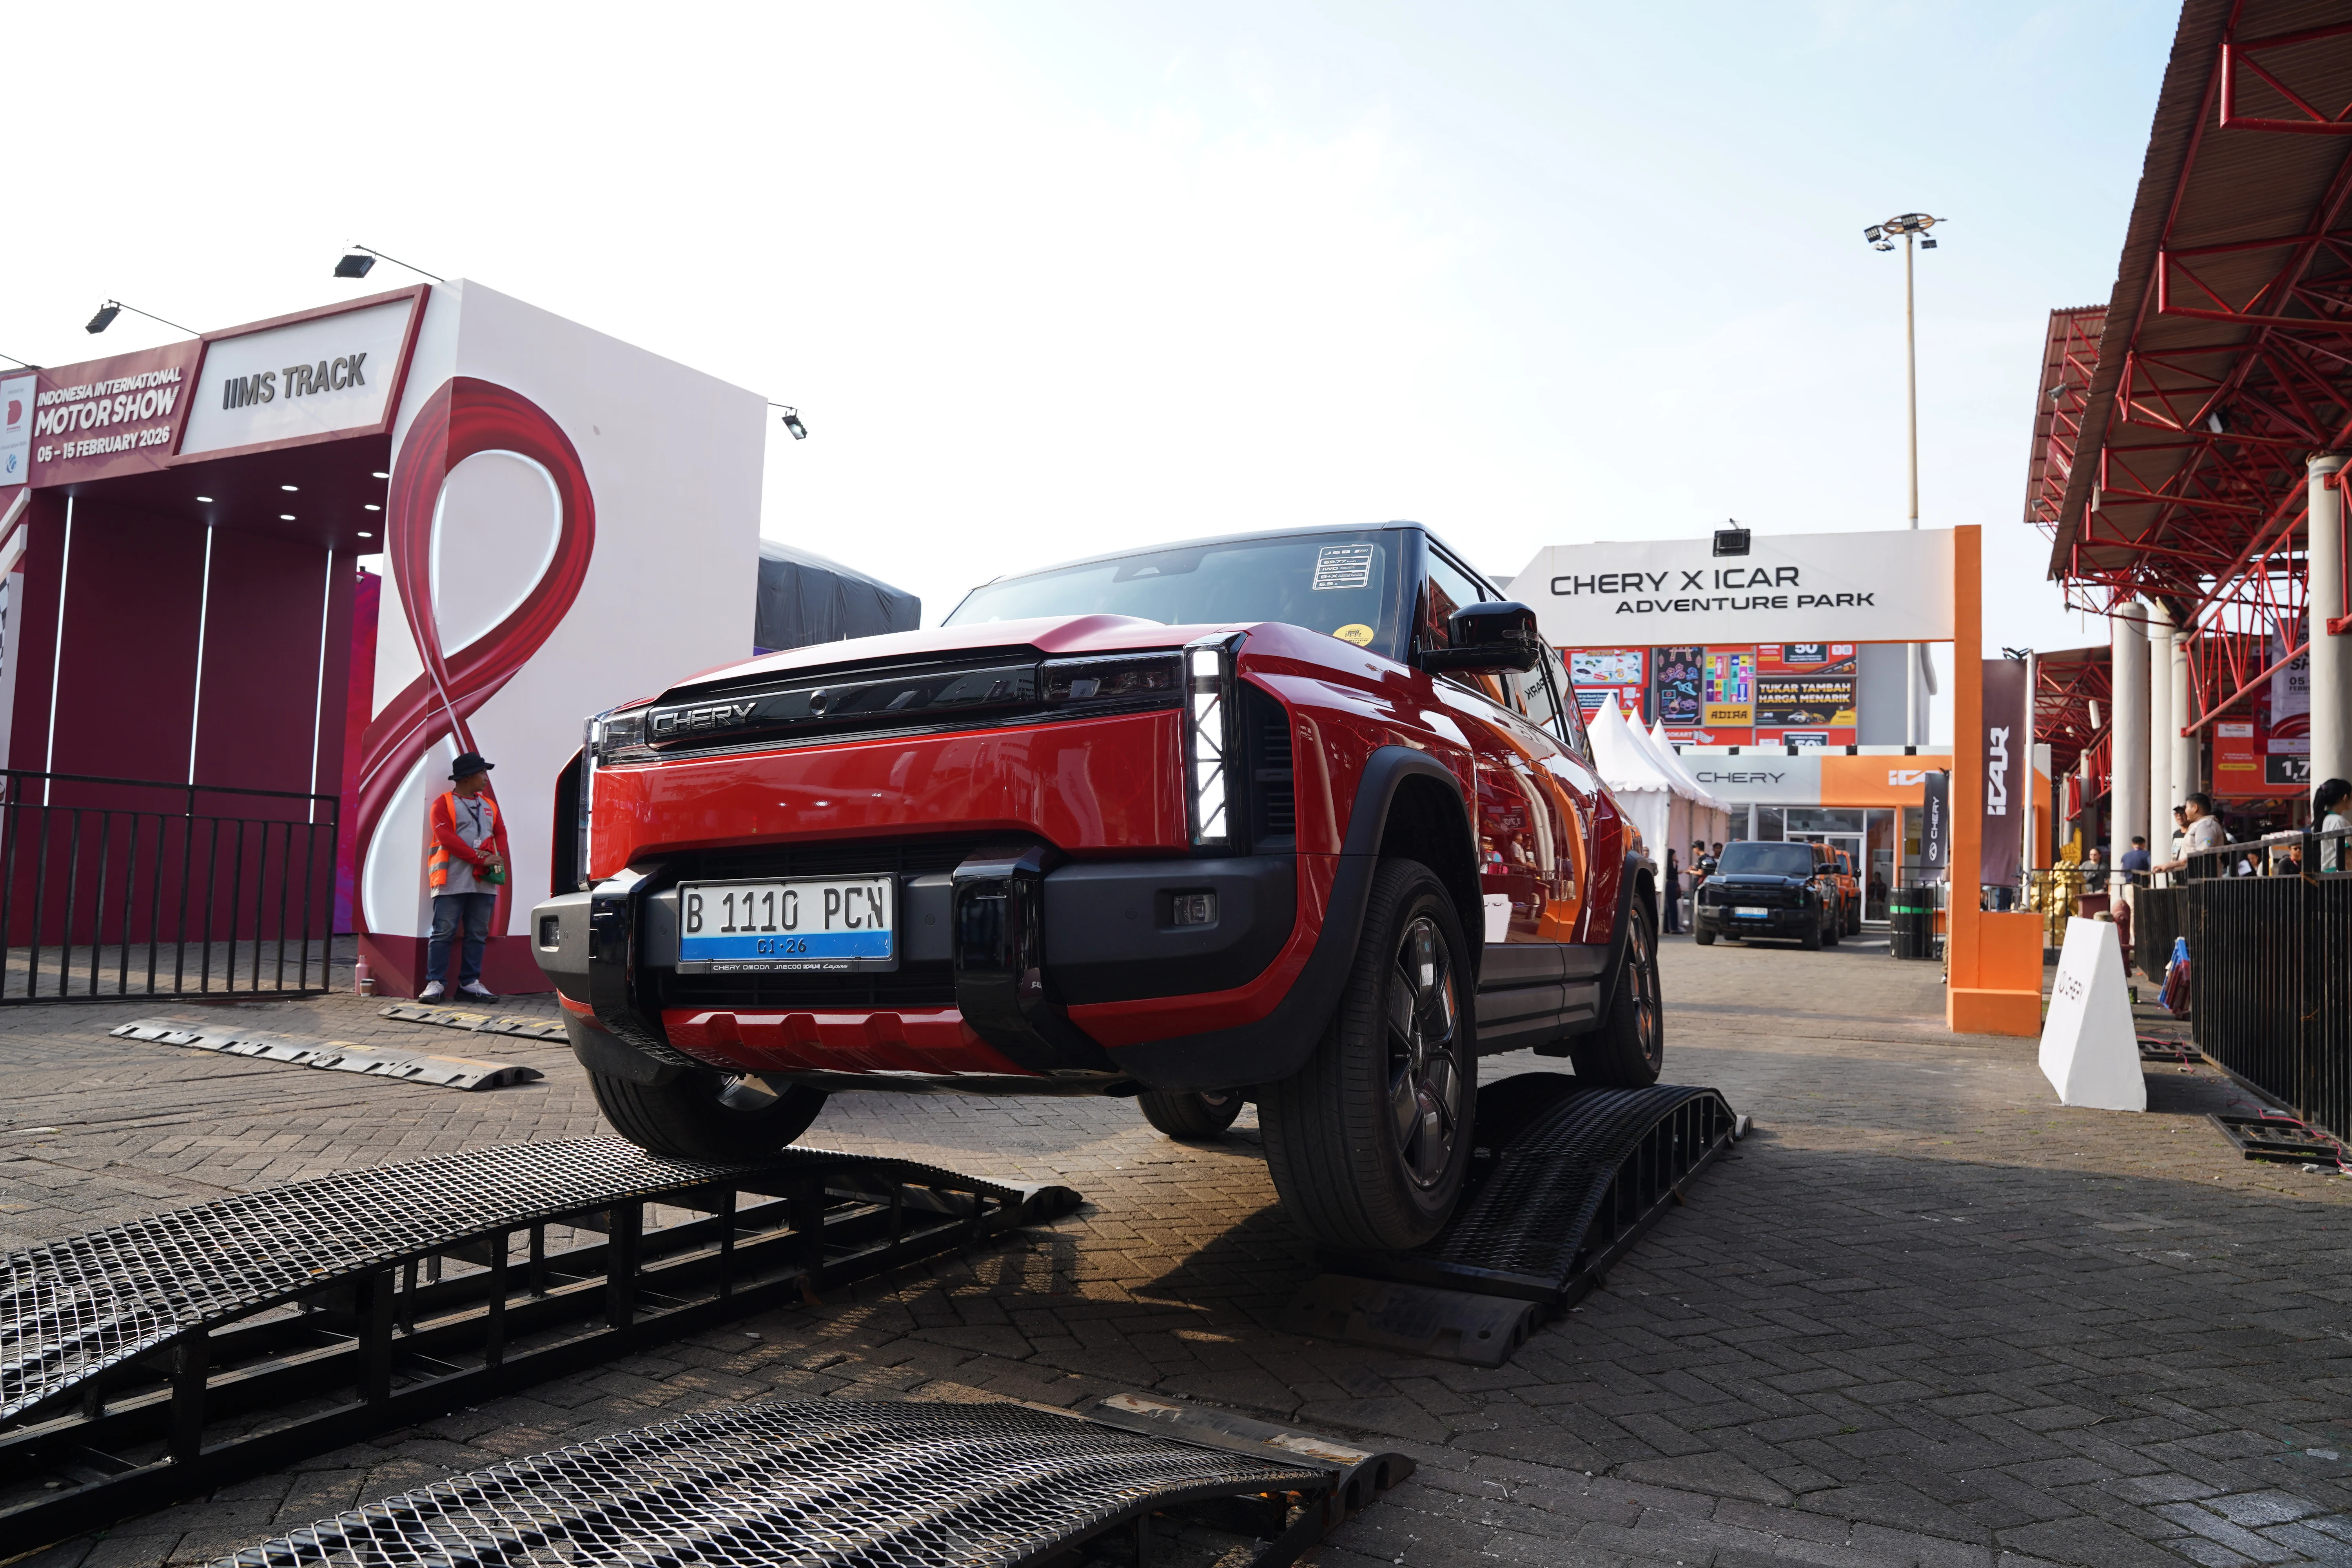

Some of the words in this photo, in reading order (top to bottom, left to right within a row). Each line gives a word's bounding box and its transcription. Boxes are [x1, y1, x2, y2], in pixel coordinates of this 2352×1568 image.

[37, 383, 93, 407] INDONESIA
[94, 366, 181, 397] INTERNATIONAL
[223, 371, 276, 410] IIMS
[282, 352, 367, 398] TRACK
[37, 445, 53, 463] 05
[63, 441, 75, 459] 15
[76, 432, 140, 457] FEBRUARY
[139, 425, 171, 447] 2026
[1550, 570, 1669, 597] CHERY
[1680, 570, 1703, 591] X
[1714, 566, 1800, 590] ICAR
[1615, 595, 1788, 614] ADVENTURE
[1797, 592, 1875, 609] PARK
[1758, 694, 1797, 703] HARGA
[1799, 693, 1851, 703] MENARIK
[1759, 684, 1799, 693] TUKAR
[1800, 682, 1851, 693] TAMBAH
[653, 702, 758, 735] CHERY
[1711, 711, 1747, 719] ADIRA
[1696, 772, 1786, 784] CHERY
[1931, 796, 1939, 839] CHERY
[687, 893, 703, 933] B
[720, 889, 799, 932] 1110
[824, 886, 884, 930] PCN
